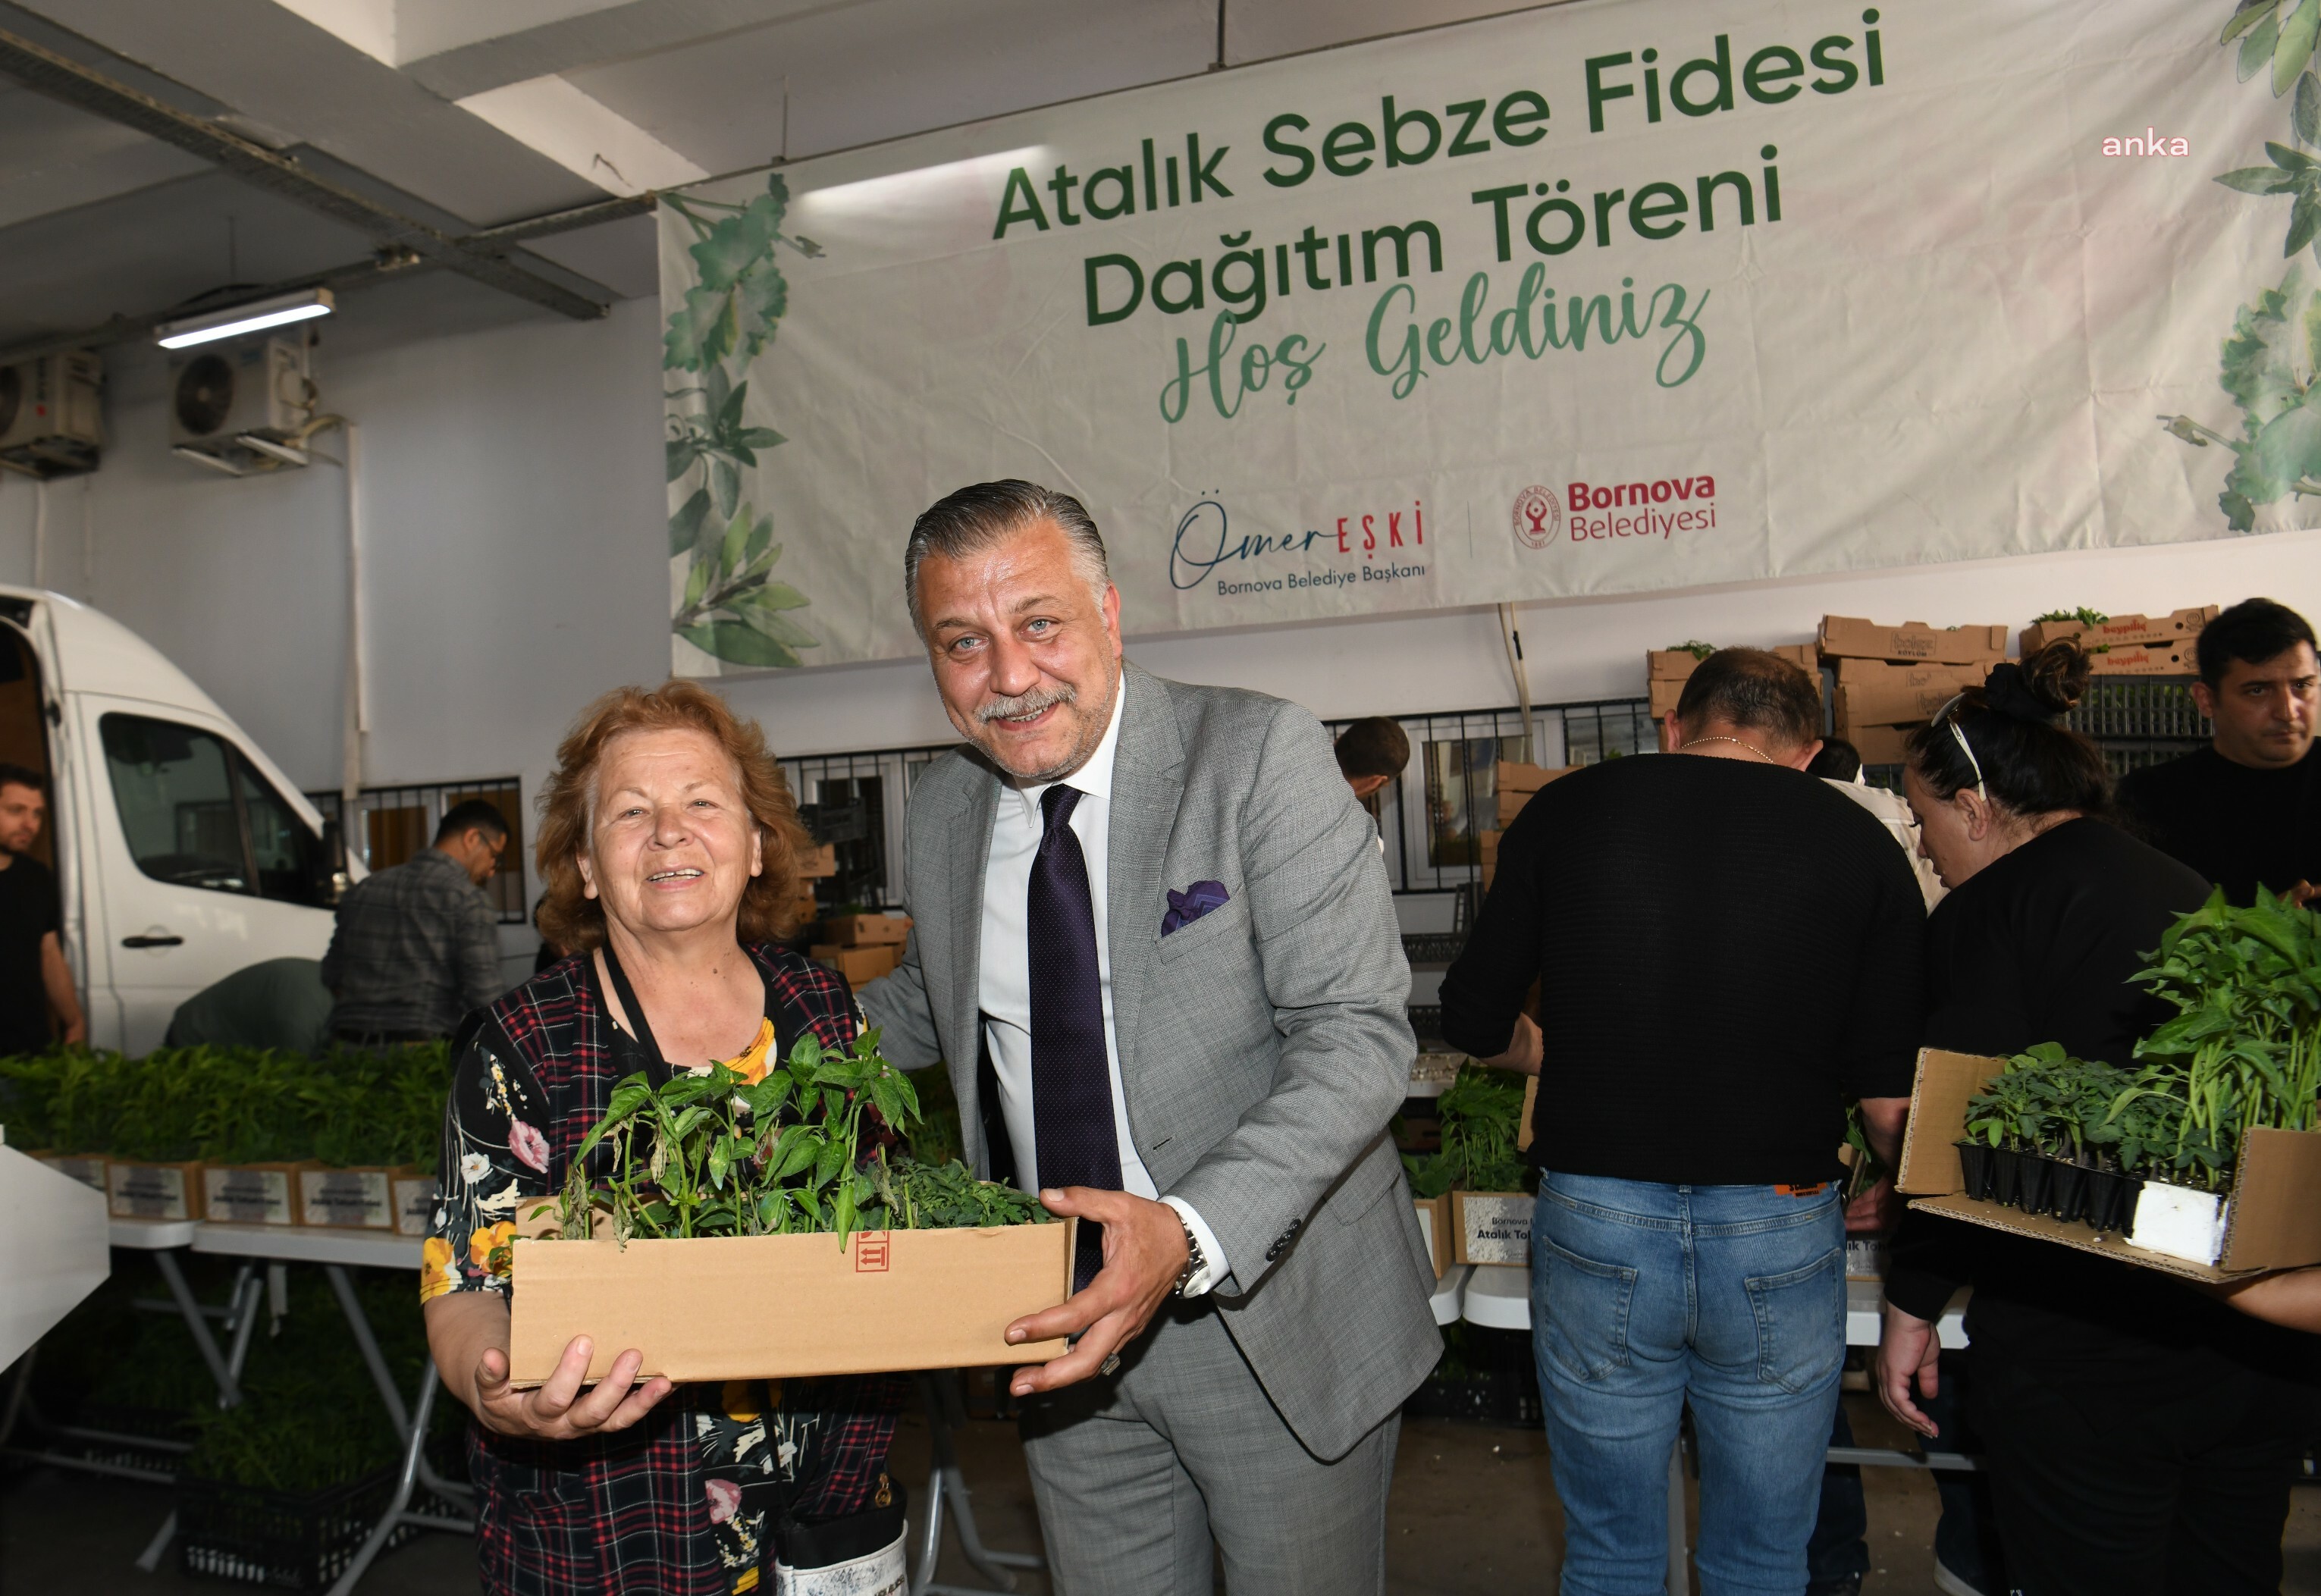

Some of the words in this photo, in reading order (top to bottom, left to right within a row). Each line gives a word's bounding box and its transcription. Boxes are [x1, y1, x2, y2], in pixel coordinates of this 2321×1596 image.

[993, 133, 1234, 240] Atalık
[1263, 90, 1550, 188] Sebze
[1585, 8, 1884, 133] Fidesi
[1084, 220, 1443, 325] Dağıtım
[1472, 144, 1781, 262] Töreni
[1160, 309, 1325, 423] Hoş
[1366, 262, 1711, 400] Geldiniz
[1567, 475, 1715, 512] Bornova
[1169, 489, 1338, 590] Ömer
[1337, 500, 1424, 560] EŞKİ
[1570, 503, 1717, 541] Belediyesi
[1218, 579, 1283, 596] Bornova
[1288, 567, 1357, 589] Belediye
[1363, 563, 1426, 584] Başkanı
[1478, 1230, 1511, 1240] Atalık
[1492, 1217, 1528, 1225] Bornova
